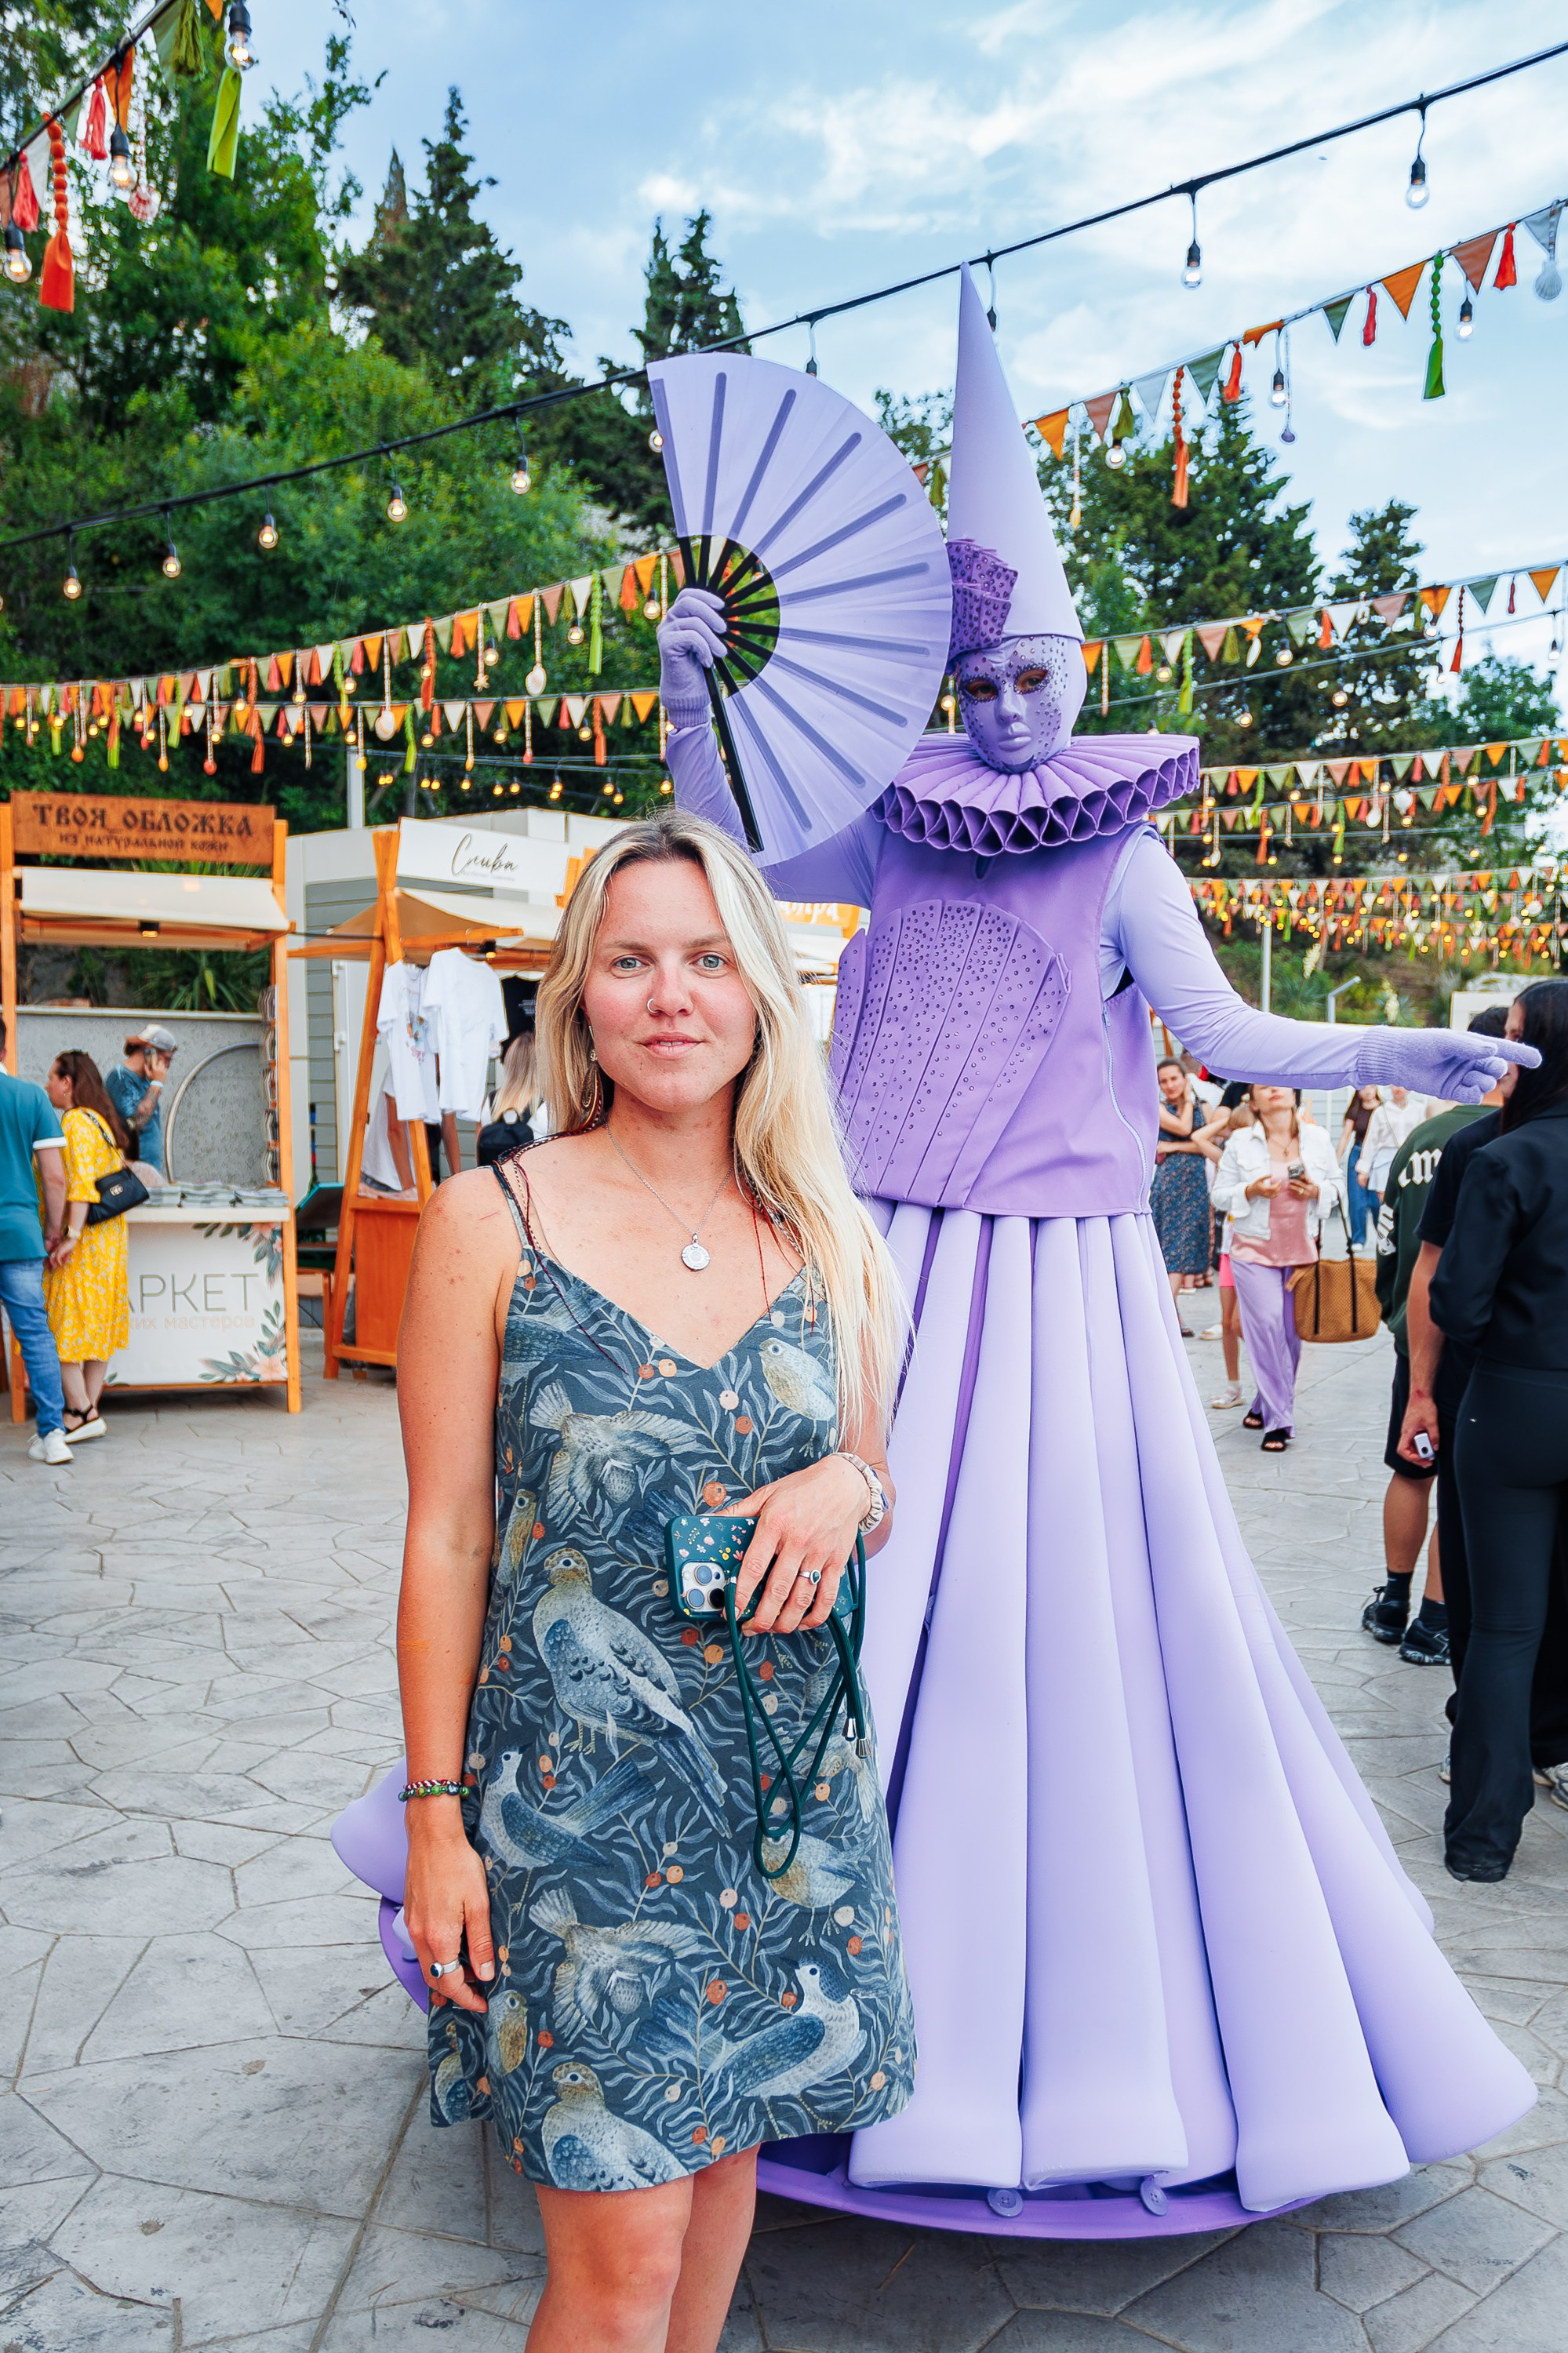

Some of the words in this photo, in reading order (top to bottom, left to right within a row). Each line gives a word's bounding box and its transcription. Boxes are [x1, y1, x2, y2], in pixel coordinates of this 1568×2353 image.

[32, 803, 106, 828] ТВОЯ
[122, 809, 253, 836] ОБЛОЖКА
[129, 1272, 259, 1314] РКЕТ
[164, 1315, 256, 1333] мастеров
